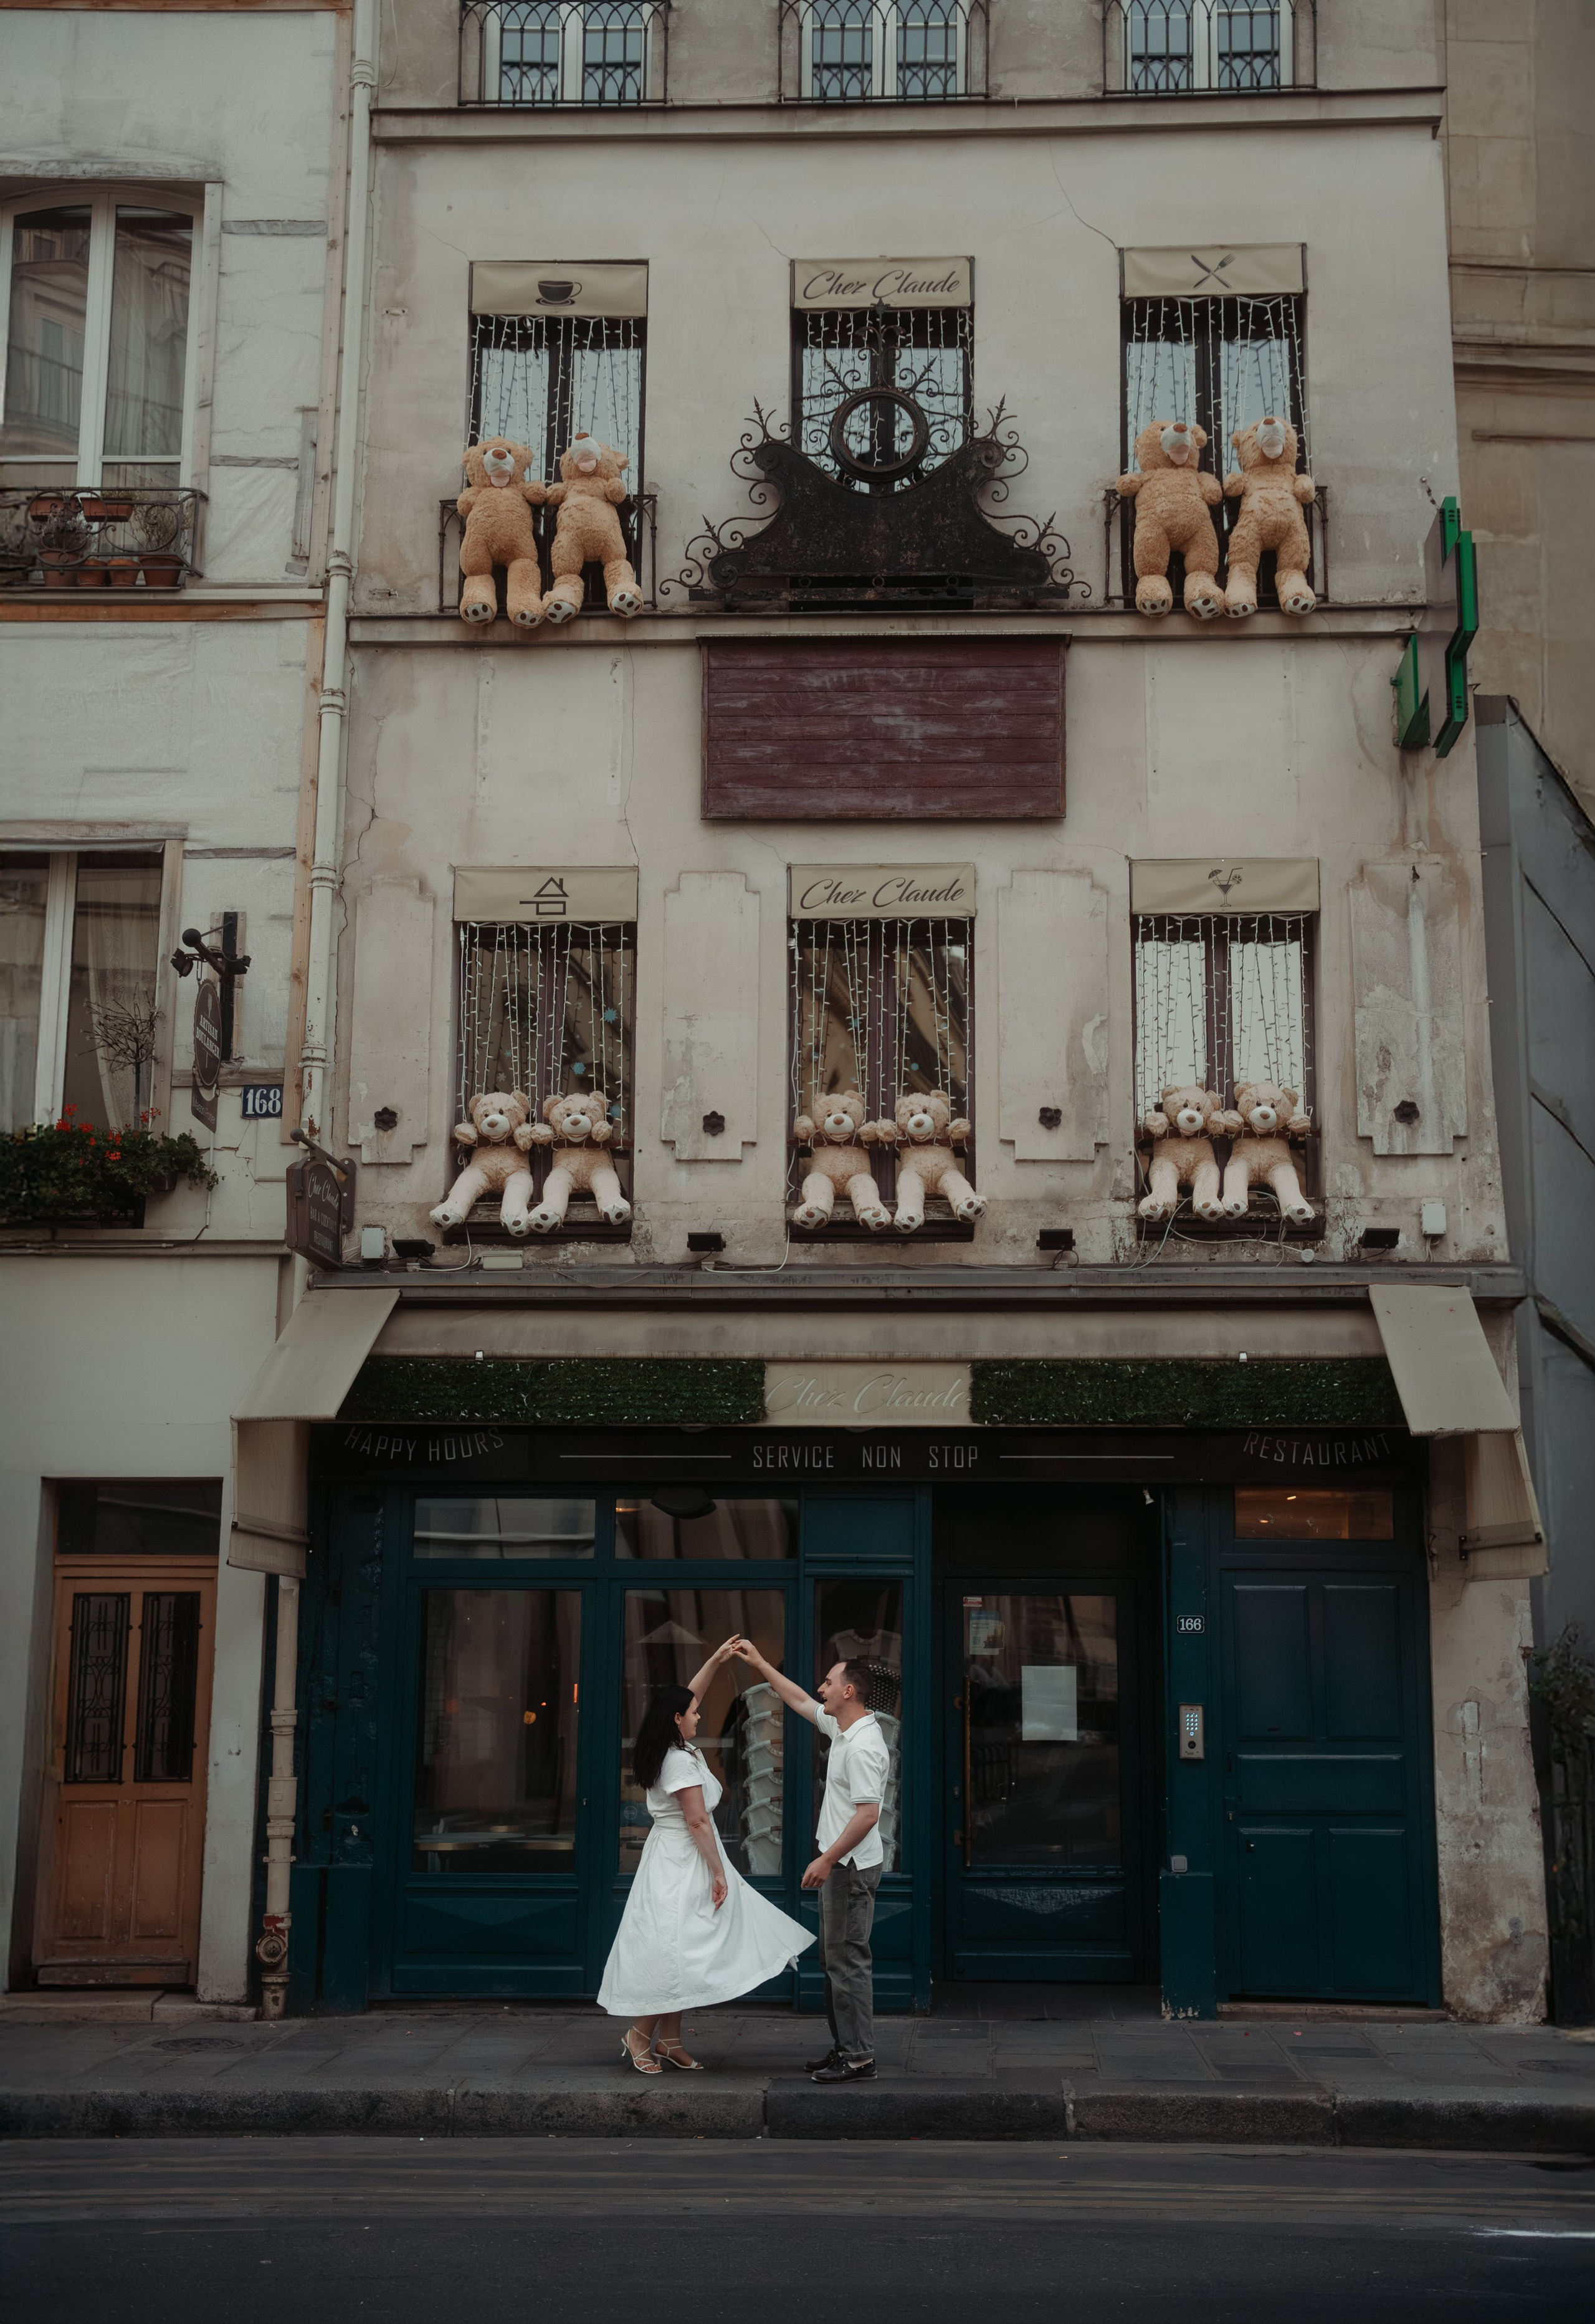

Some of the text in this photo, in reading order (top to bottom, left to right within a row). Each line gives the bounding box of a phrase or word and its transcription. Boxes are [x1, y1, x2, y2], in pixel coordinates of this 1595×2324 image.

[802, 269, 963, 300] Chez Claude
[800, 877, 966, 910] Chez Claude
[196, 1026, 220, 1059] BOULANGER
[199, 1014, 218, 1041] ARTISAN
[245, 1088, 282, 1115] 168
[308, 1173, 339, 1210] Chez Claude
[765, 1374, 970, 1414] Chez Claude
[344, 1426, 504, 1461] HAPPY HOURS
[753, 1445, 978, 1468] SERVICE NON STOP
[1243, 1431, 1391, 1465] RESTAURANT
[1179, 1617, 1202, 1631] 166
